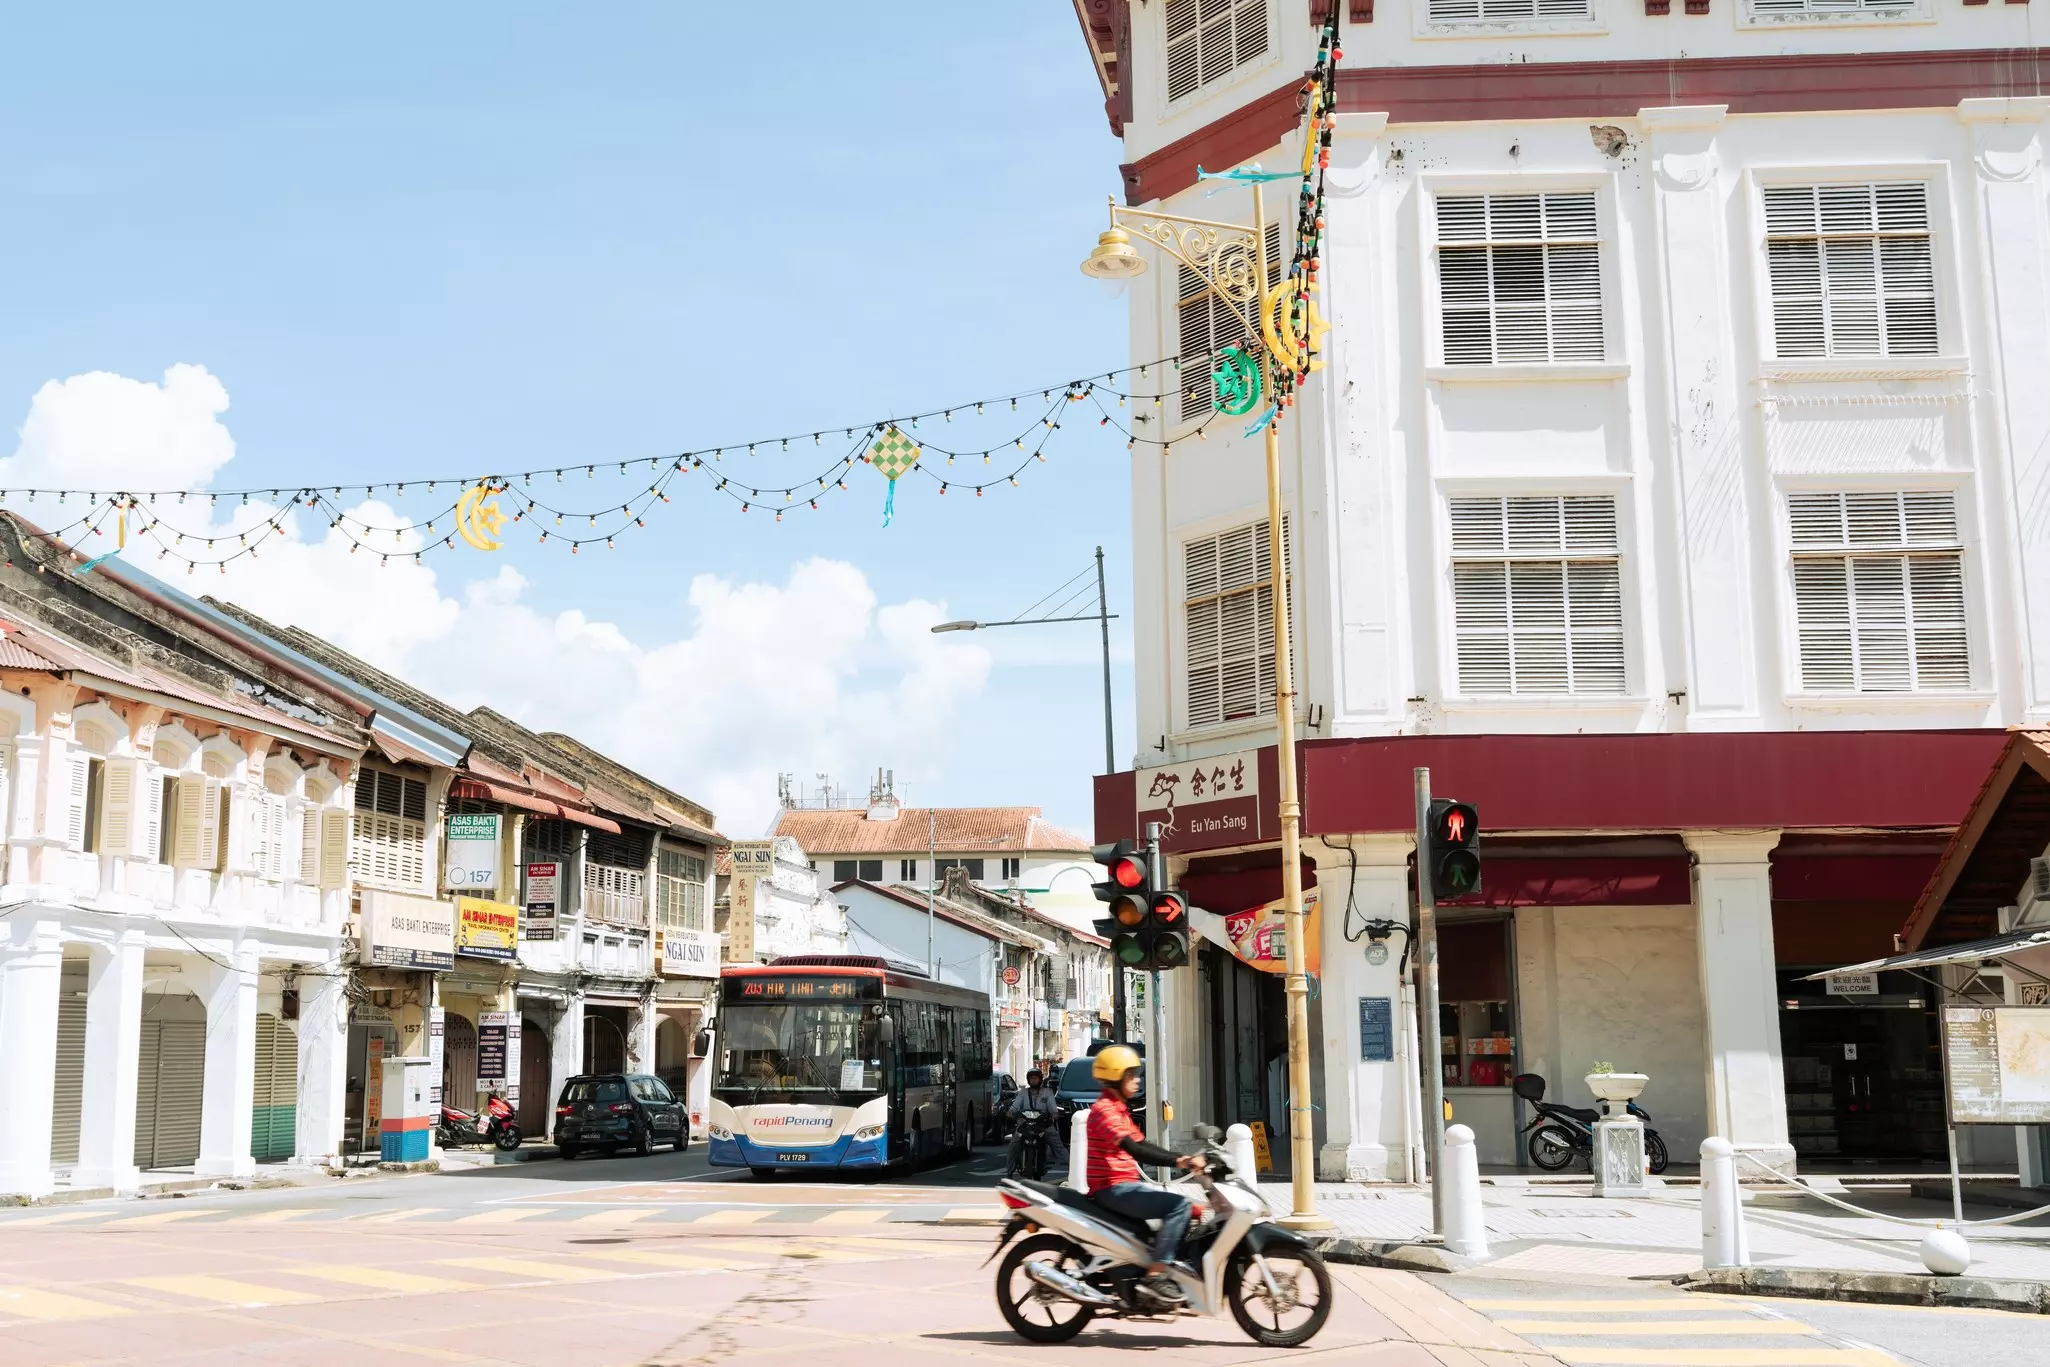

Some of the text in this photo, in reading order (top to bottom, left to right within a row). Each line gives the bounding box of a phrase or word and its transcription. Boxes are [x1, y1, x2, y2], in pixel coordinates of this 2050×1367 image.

[1190, 759, 1245, 798] 余仁生
[451, 815, 495, 826] ASAS BAKTI
[1191, 815, 1247, 833] Eu Yan Sang
[450, 826, 495, 835] ENTERPRISE
[733, 851, 771, 863] NGAI SUN
[470, 871, 492, 883] 157
[391, 916, 451, 937] ASAS BAKTI ENTERPRISE
[665, 941, 705, 962] NGAI SUN
[1371, 950, 1384, 958] ADT
[404, 1024, 421, 1033] 157
[753, 1116, 834, 1128] rapidPenang
